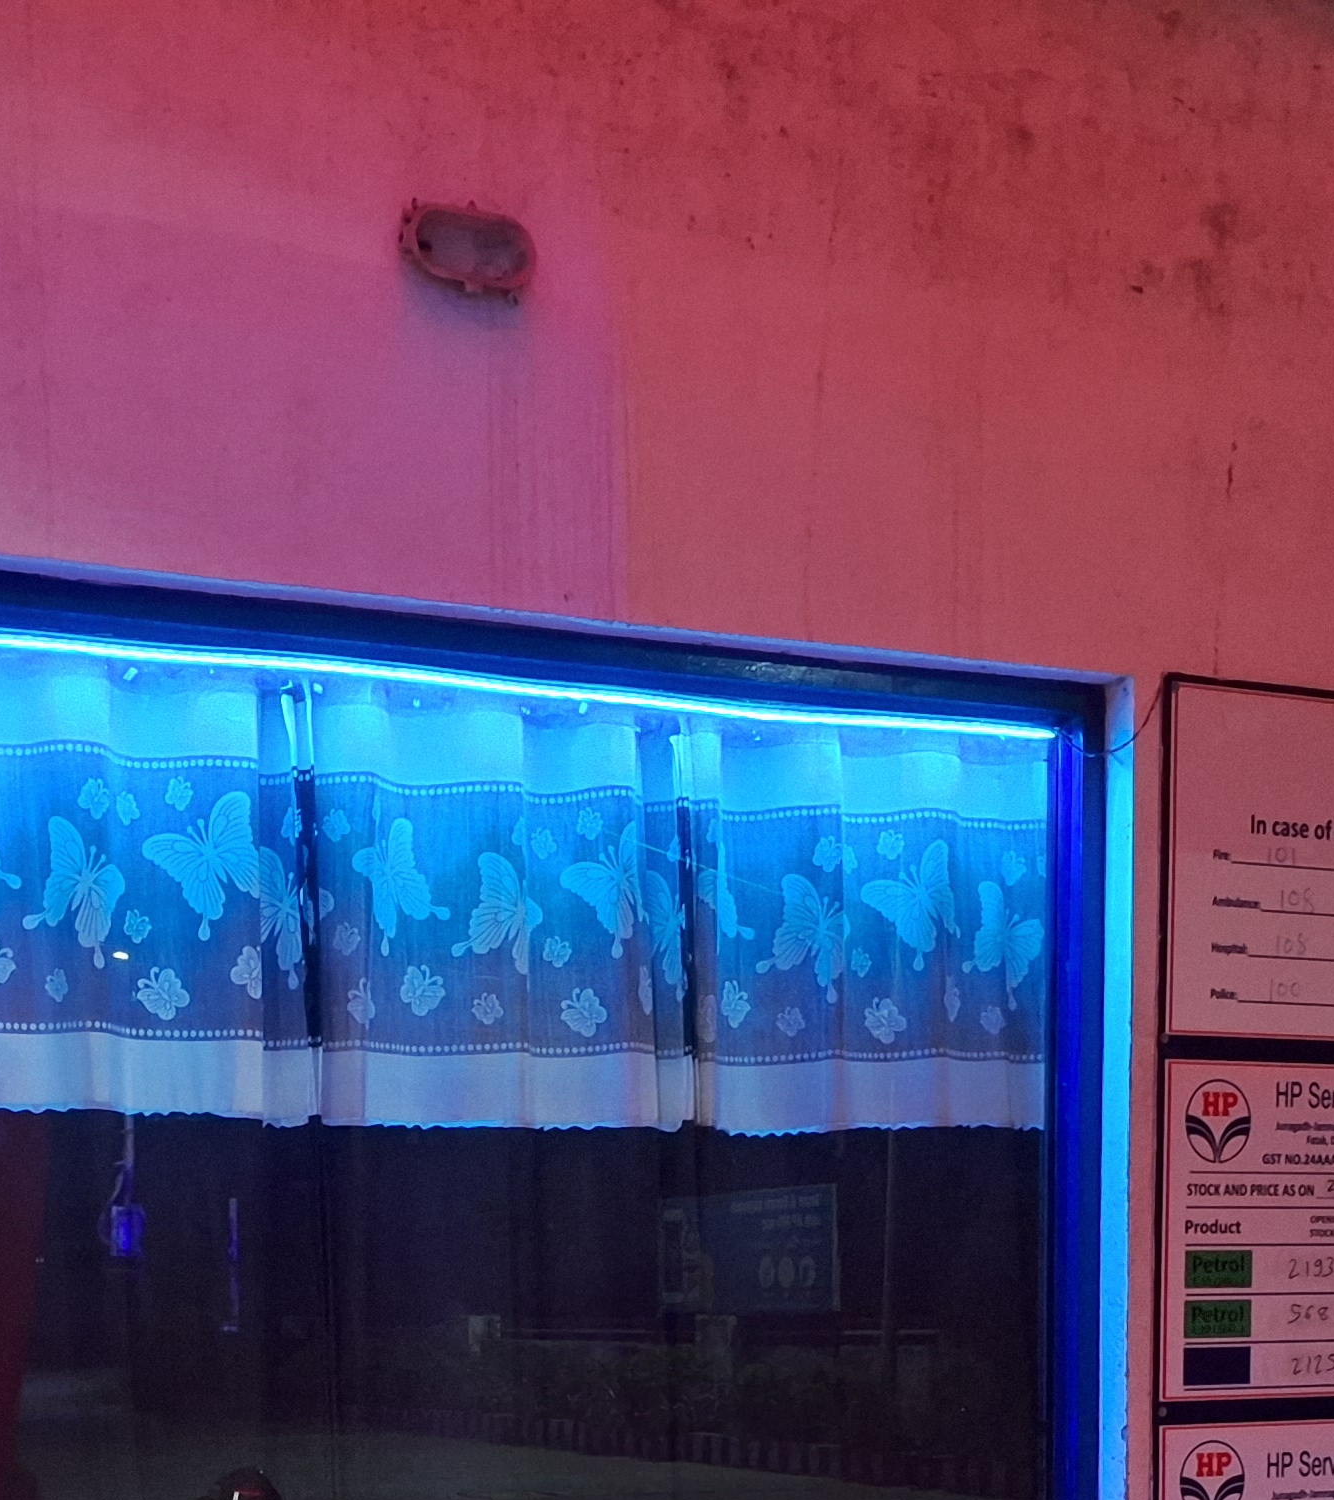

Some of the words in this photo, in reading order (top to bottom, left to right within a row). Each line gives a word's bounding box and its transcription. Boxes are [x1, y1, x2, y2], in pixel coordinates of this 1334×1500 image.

[1250, 814, 1267, 835] In
[1272, 820, 1310, 839] case
[1313, 818, 1333, 841] of
[1201, 1091, 1239, 1117] HP
[1275, 1081, 1302, 1108] HP
[1262, 1153, 1282, 1165] GST
[1187, 1183, 1222, 1197] STOCK
[1223, 1183, 1248, 1197] AND
[1250, 1184, 1279, 1197] PRICE
[1282, 1184, 1296, 1197] AS
[1298, 1184, 1315, 1197] ON
[1184, 1218, 1242, 1235] Product
[1288, 1256, 1334, 1279] 2193
[1195, 1452, 1233, 1477] HP
[1266, 1451, 1293, 1479] HP
